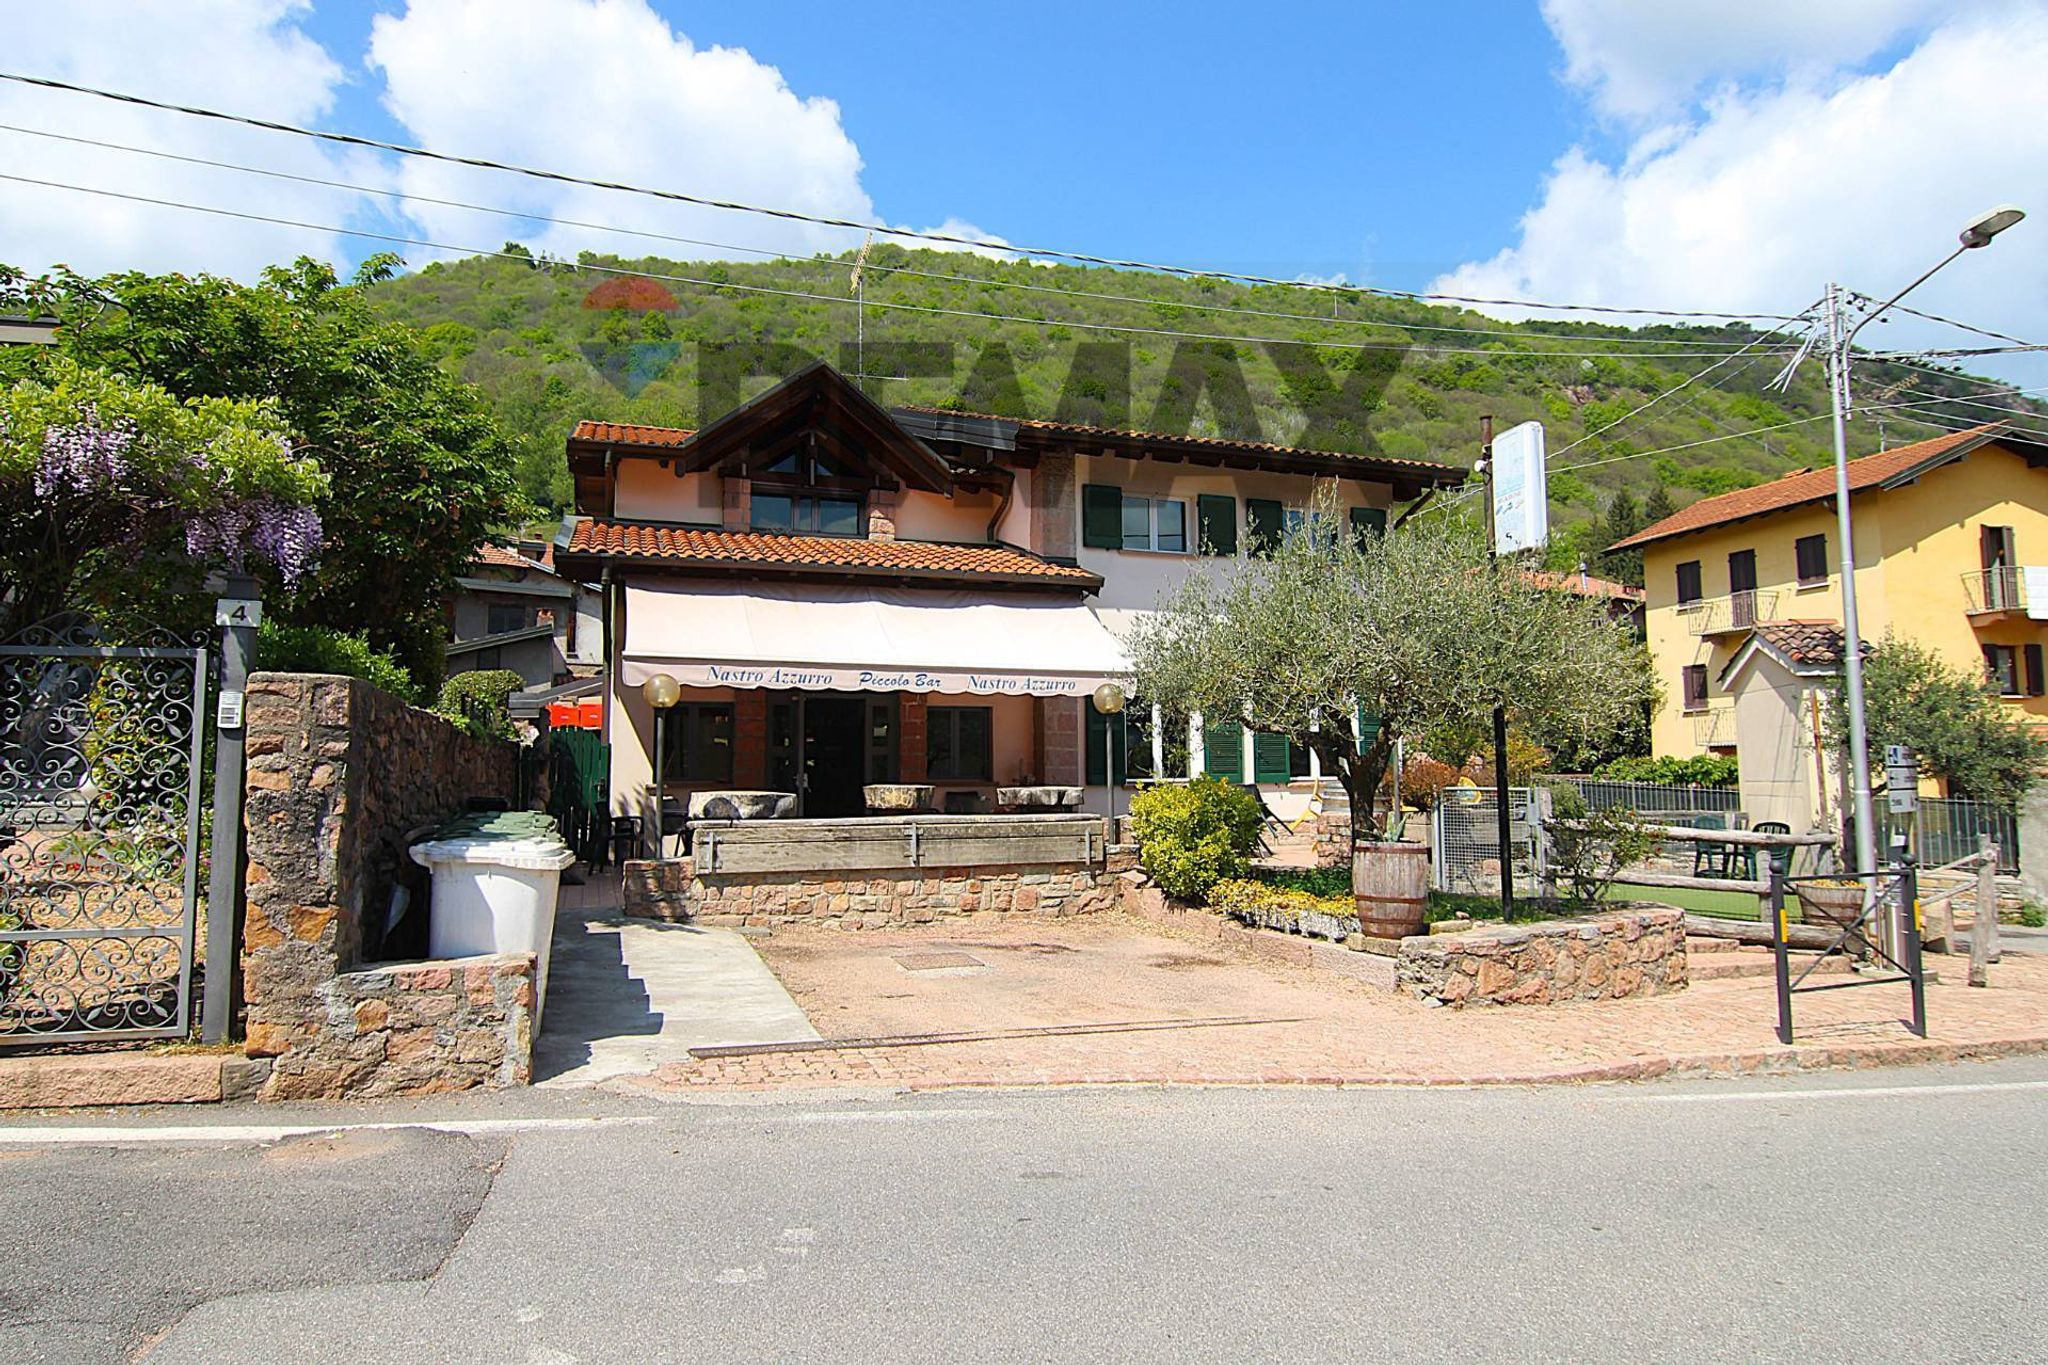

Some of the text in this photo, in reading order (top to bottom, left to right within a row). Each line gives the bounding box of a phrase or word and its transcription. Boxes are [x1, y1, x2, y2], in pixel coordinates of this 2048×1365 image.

[231, 605, 247, 621] 4
[706, 666, 833, 685] Nastro Azzurro
[858, 671, 941, 687] Piccolo Bar
[967, 675, 1076, 691] Nastro Azzurro
